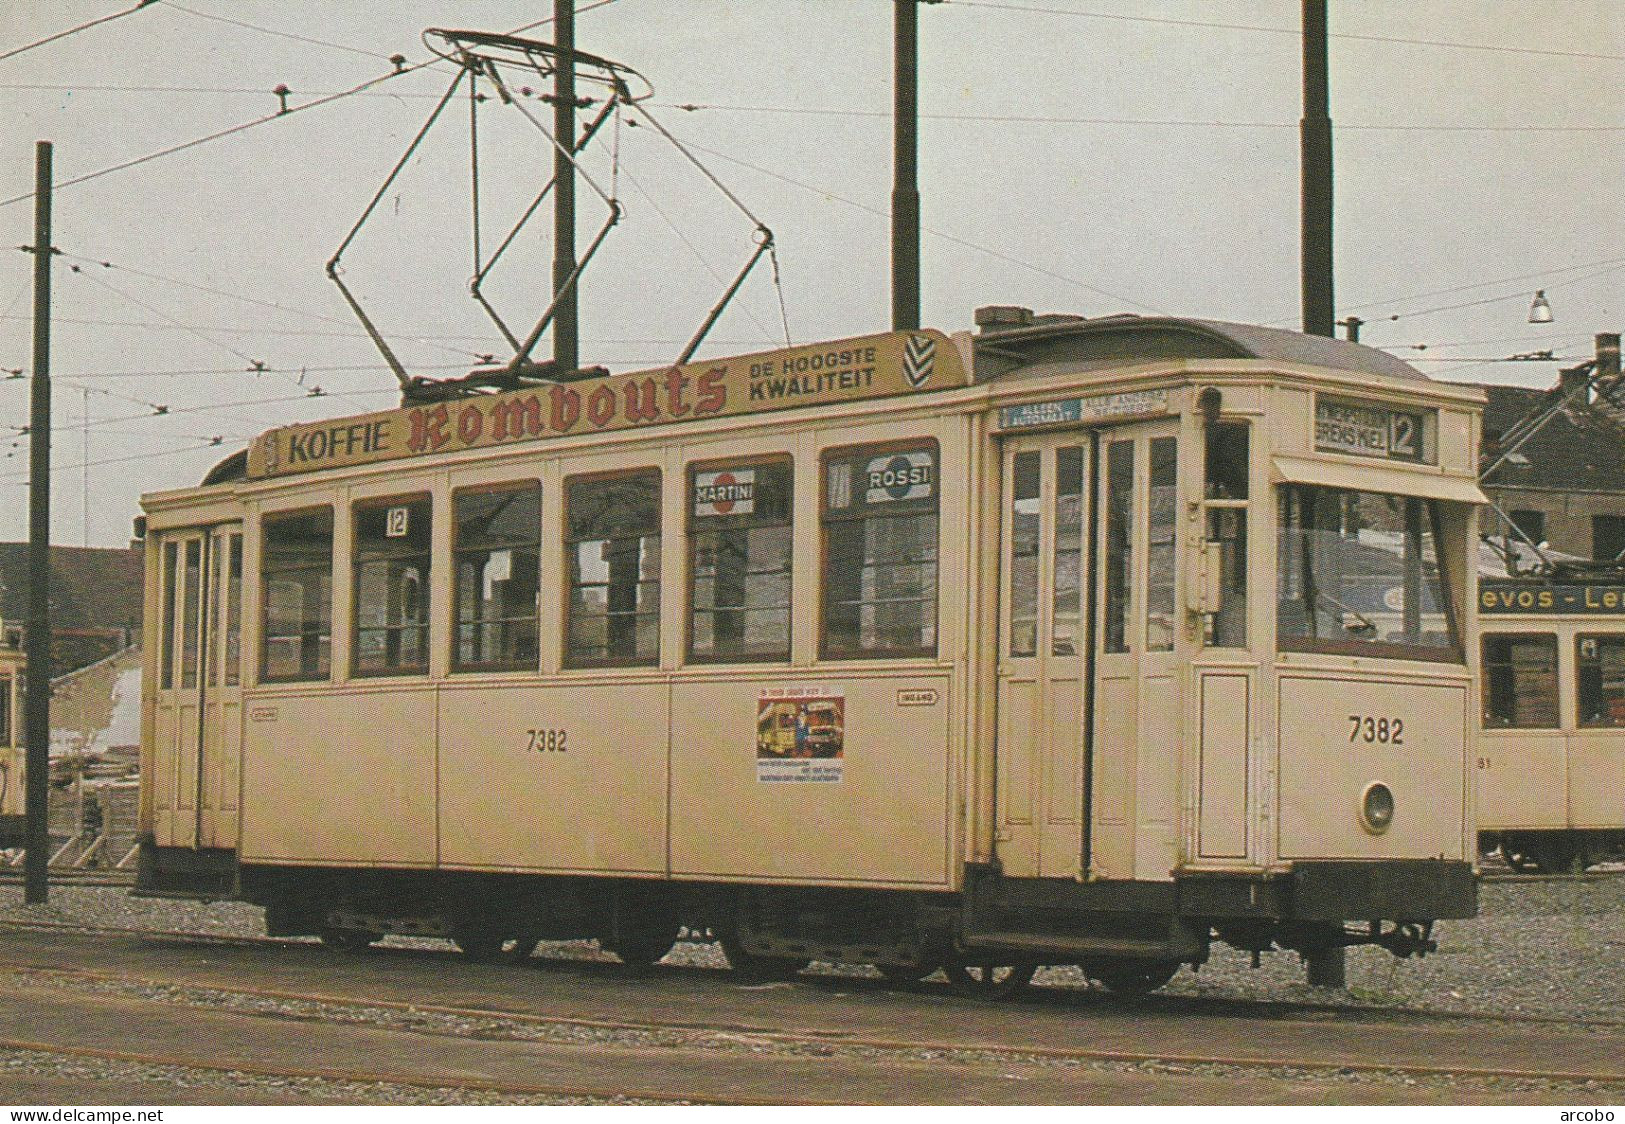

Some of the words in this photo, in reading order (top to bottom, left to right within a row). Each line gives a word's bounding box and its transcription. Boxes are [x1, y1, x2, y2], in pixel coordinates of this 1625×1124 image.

[750, 361, 773, 379] DE
[783, 347, 875, 372] HOOGSTE
[750, 367, 876, 401] KWALITEIT
[288, 419, 391, 464] KOFFIE
[407, 366, 729, 452] Rombouts
[1390, 415, 1416, 455] 12
[696, 483, 753, 502] MARTINI
[868, 469, 930, 489] ROSSI
[389, 509, 405, 534] 12
[1481, 590, 1554, 609] evos
[526, 729, 568, 752] 7382
[1348, 715, 1404, 745] 7382
